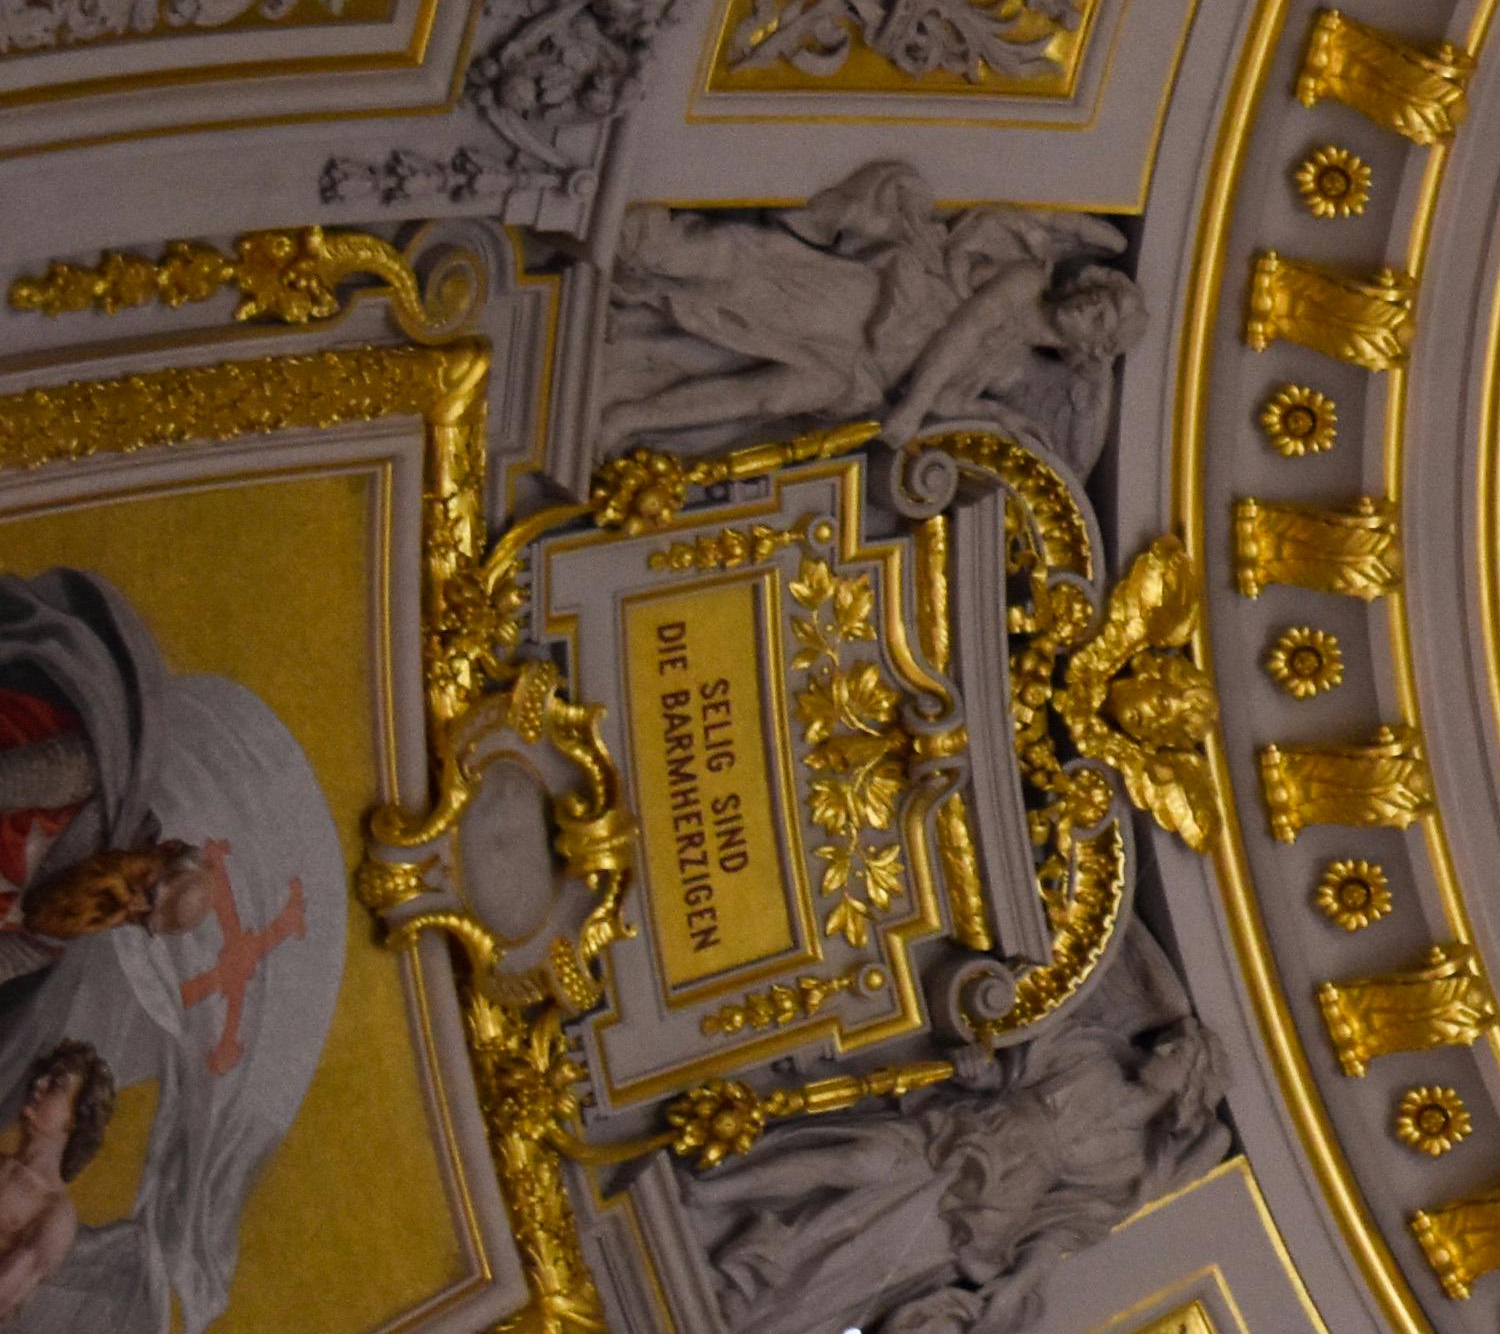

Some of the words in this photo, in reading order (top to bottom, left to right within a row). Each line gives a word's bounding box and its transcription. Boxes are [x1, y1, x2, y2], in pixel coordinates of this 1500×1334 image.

[657, 621, 687, 675] DIE
[700, 678, 735, 774] SELIG
[661, 690, 720, 953] BARMHERZIGEN
[711, 792, 749, 873] SIND
